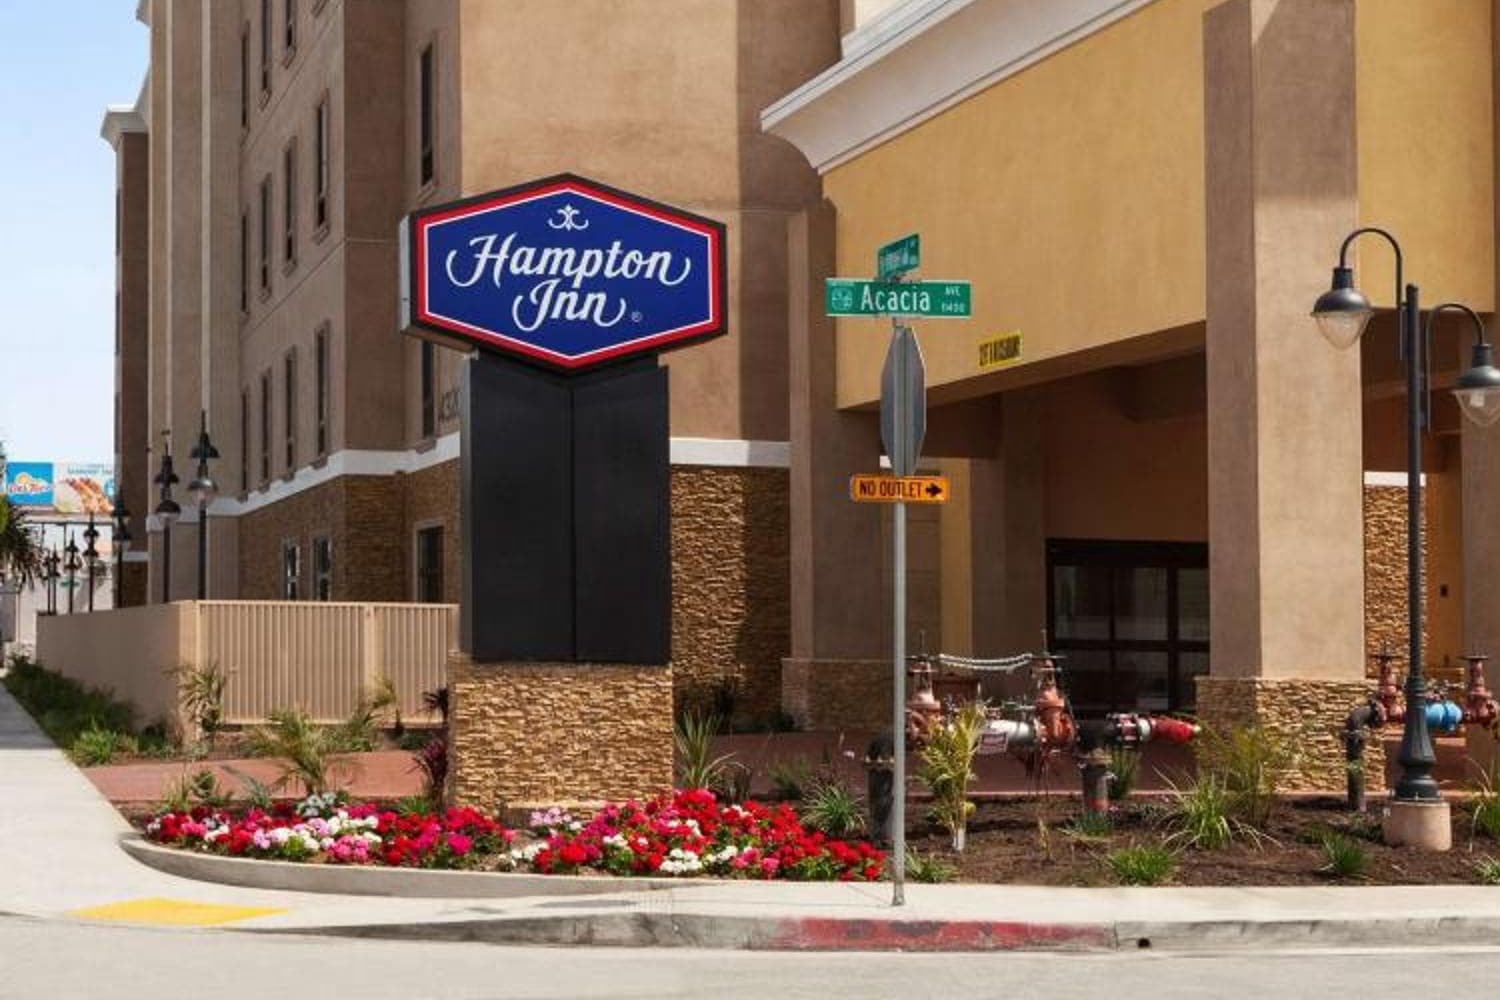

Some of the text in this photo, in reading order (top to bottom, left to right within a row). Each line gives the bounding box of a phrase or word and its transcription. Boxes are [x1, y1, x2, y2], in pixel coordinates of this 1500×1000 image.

[445, 232, 691, 288] Hampton
[512, 278, 627, 332] Inn
[860, 284, 930, 312] Acacia
[860, 480, 922, 497] NO OUTLET
